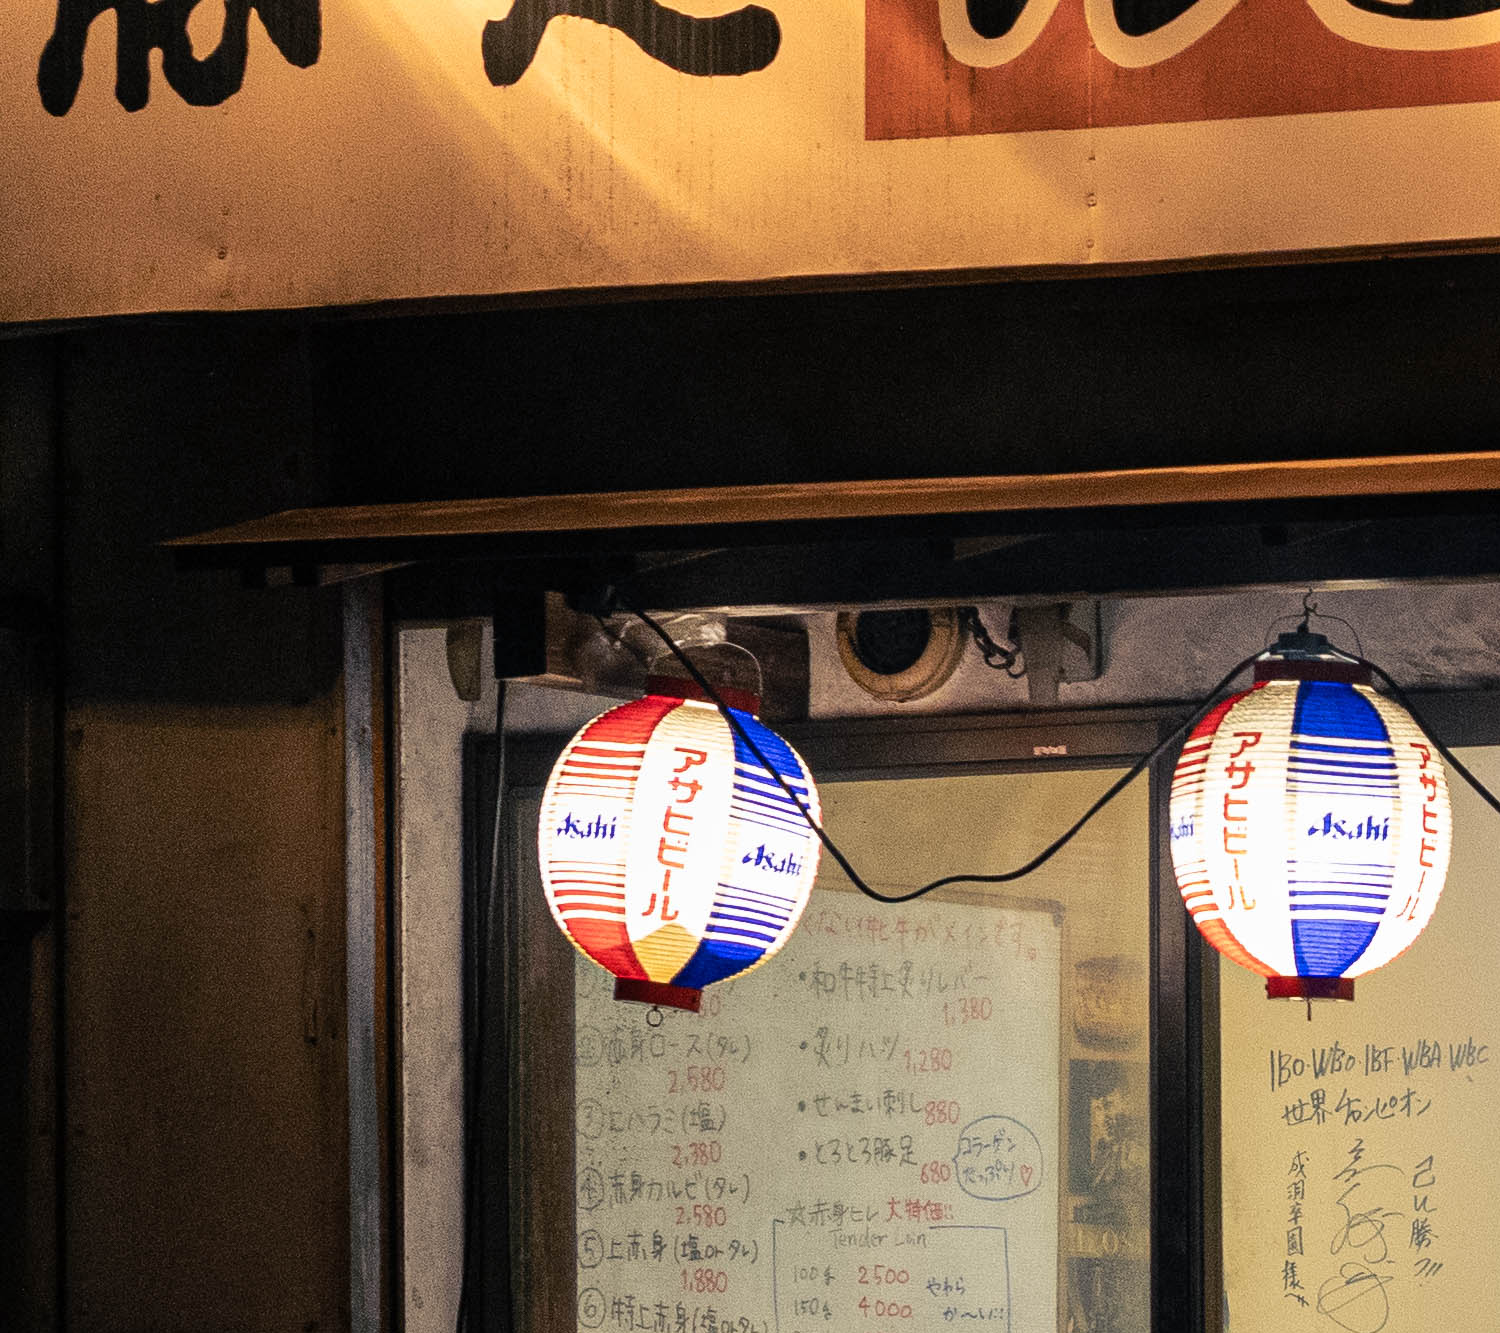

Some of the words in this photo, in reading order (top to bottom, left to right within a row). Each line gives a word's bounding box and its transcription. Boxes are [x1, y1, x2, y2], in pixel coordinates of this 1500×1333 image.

[557, 811, 617, 840] Asahi
[642, 747, 708, 921] アサヒビール
[1223, 732, 1263, 911] アサヒビール
[1308, 812, 1390, 841] Asahi
[1396, 742, 1439, 921] アサヒビール
[742, 844, 803, 876] Asahi
[924, 1100, 961, 1127] 880
[920, 1159, 951, 1185] 680
[857, 1264, 911, 1286] 2500
[857, 1296, 914, 1319] 4000
